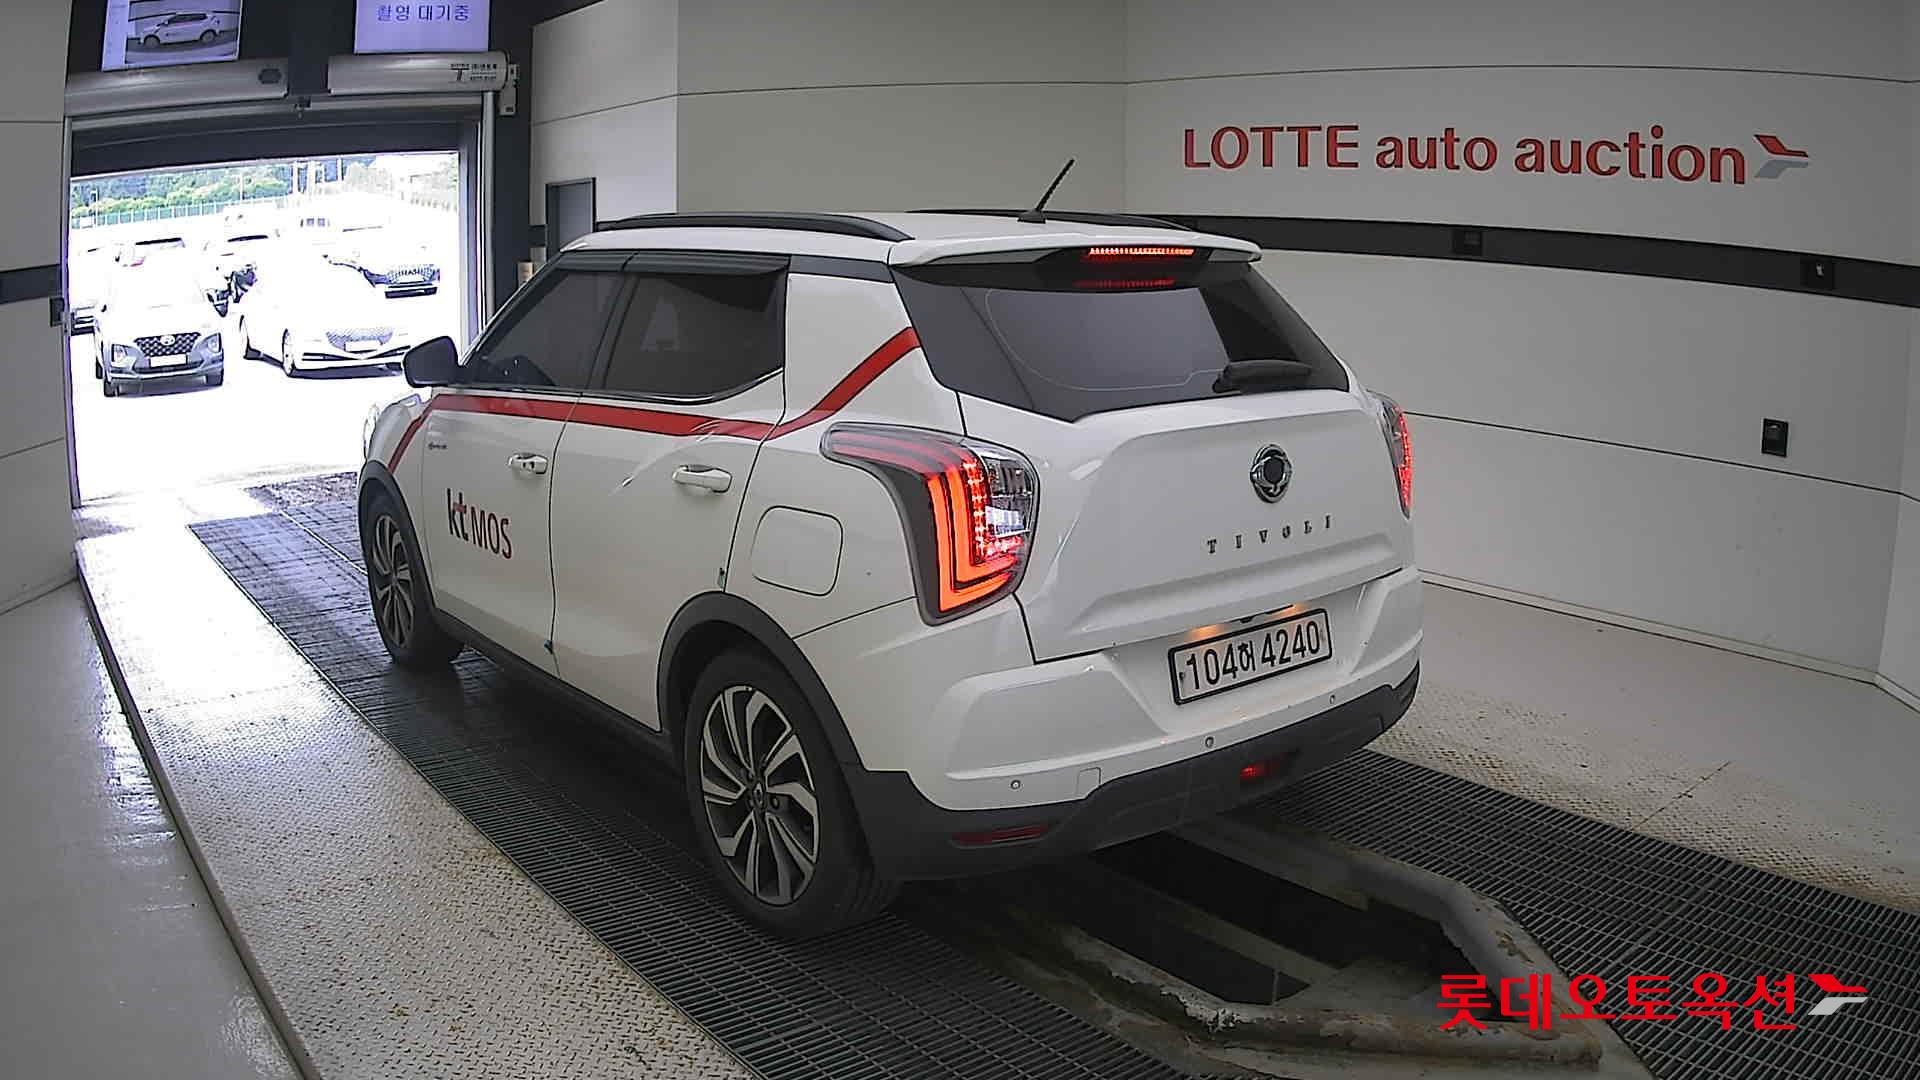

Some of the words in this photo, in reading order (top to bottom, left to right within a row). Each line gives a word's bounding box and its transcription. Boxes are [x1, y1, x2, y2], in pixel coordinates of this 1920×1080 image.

[377, 4, 411, 21] 촬영
[417, 4, 470, 21] 대기중
[1184, 124, 1360, 169] LOTTE
[1376, 127, 1498, 170] auto
[1515, 125, 1746, 185] auction
[447, 488, 469, 541] kt
[470, 506, 512, 559] MOS
[1207, 515, 1331, 554] TIVOLI
[1261, 620, 1321, 668] 4240
